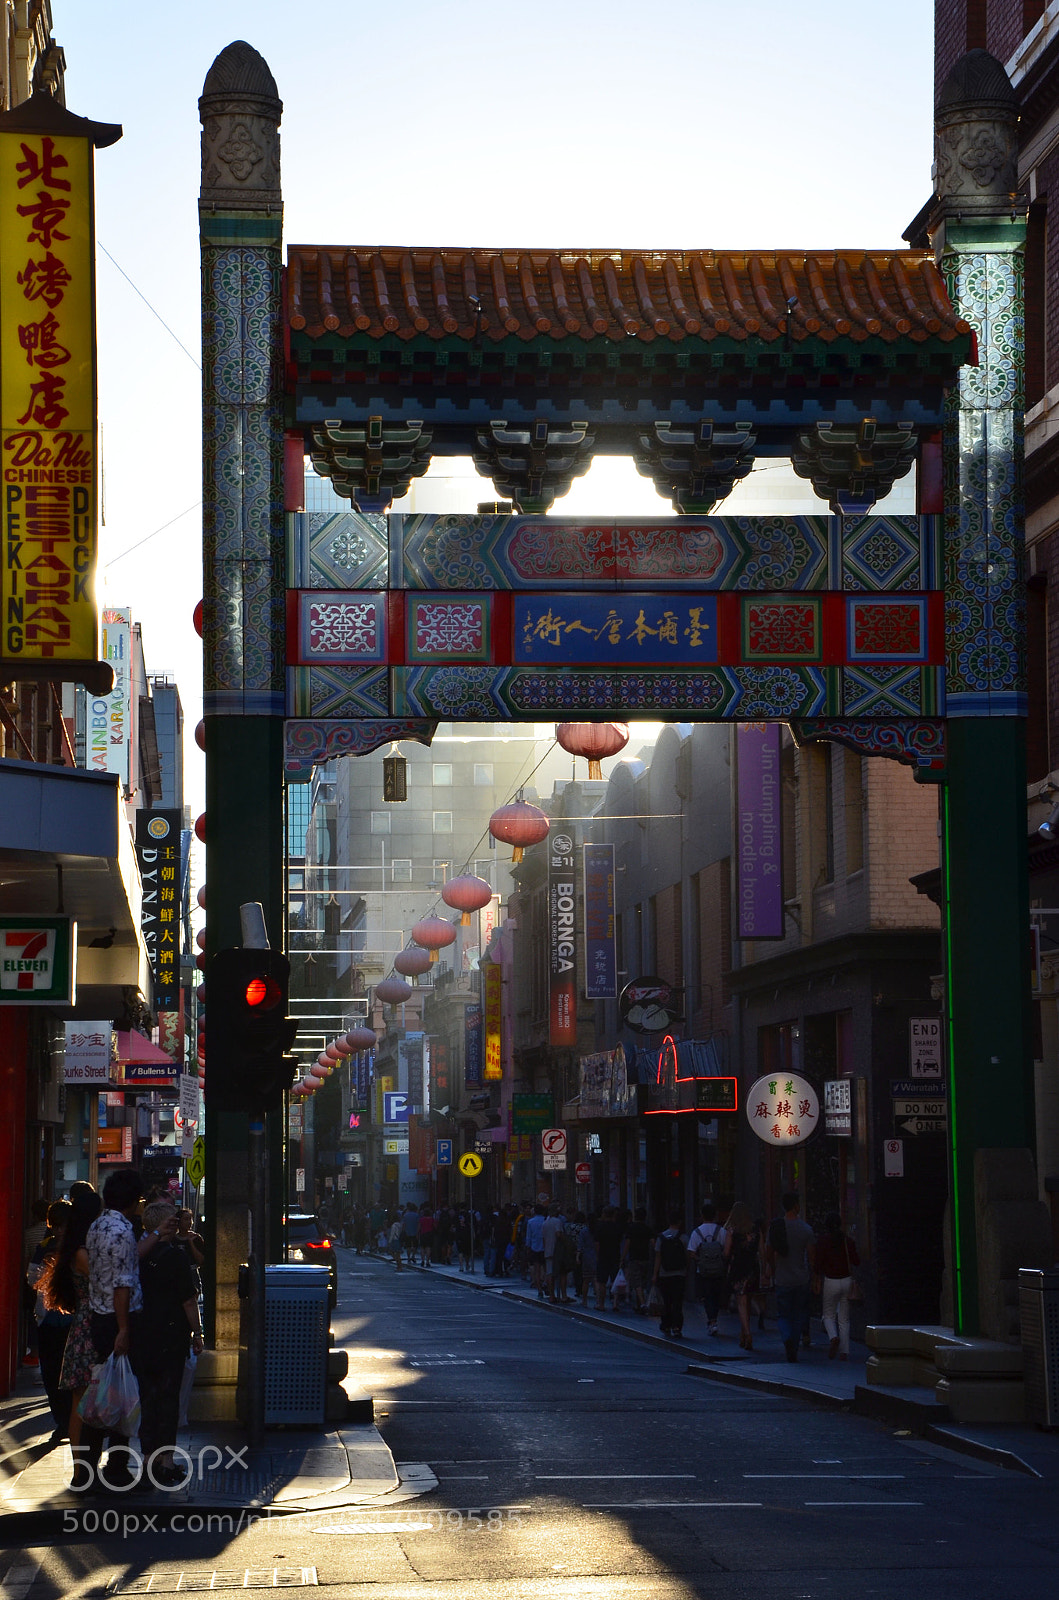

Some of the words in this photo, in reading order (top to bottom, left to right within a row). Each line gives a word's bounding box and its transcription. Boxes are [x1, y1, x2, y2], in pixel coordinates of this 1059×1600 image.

[16, 136, 72, 430] 北京烤鴨店
[4, 468, 92, 483] CHINESE
[72, 486, 90, 603] DUCK
[6, 484, 23, 653] PEKING
[24, 486, 71, 657] RESTAURANT
[761, 743, 777, 769] Jin
[759, 773, 777, 857] dumpling
[742, 812, 757, 873] noodle
[763, 864, 778, 876] &
[159, 846, 175, 985] 王朝海鮮大酒家
[743, 878, 758, 932] house
[557, 883, 575, 973] BORNGA
[606, 914, 614, 939] King
[5, 932, 48, 989] 7
[65, 1032, 106, 1047] 珍宝
[913, 1024, 938, 1036] END
[84, 1065, 106, 1078] Street
[137, 1067, 165, 1075] Bullens
[167, 1067, 177, 1075] La
[900, 1082, 939, 1092] Waratah
[390, 1096, 408, 1120] P
[753, 1099, 815, 1118] 麻辣烫
[905, 1104, 920, 1114] DO
[924, 1104, 944, 1114] NOT
[770, 1124, 801, 1138] 香锅
[915, 1121, 943, 1131] ONE
[440, 1143, 449, 1153] P
